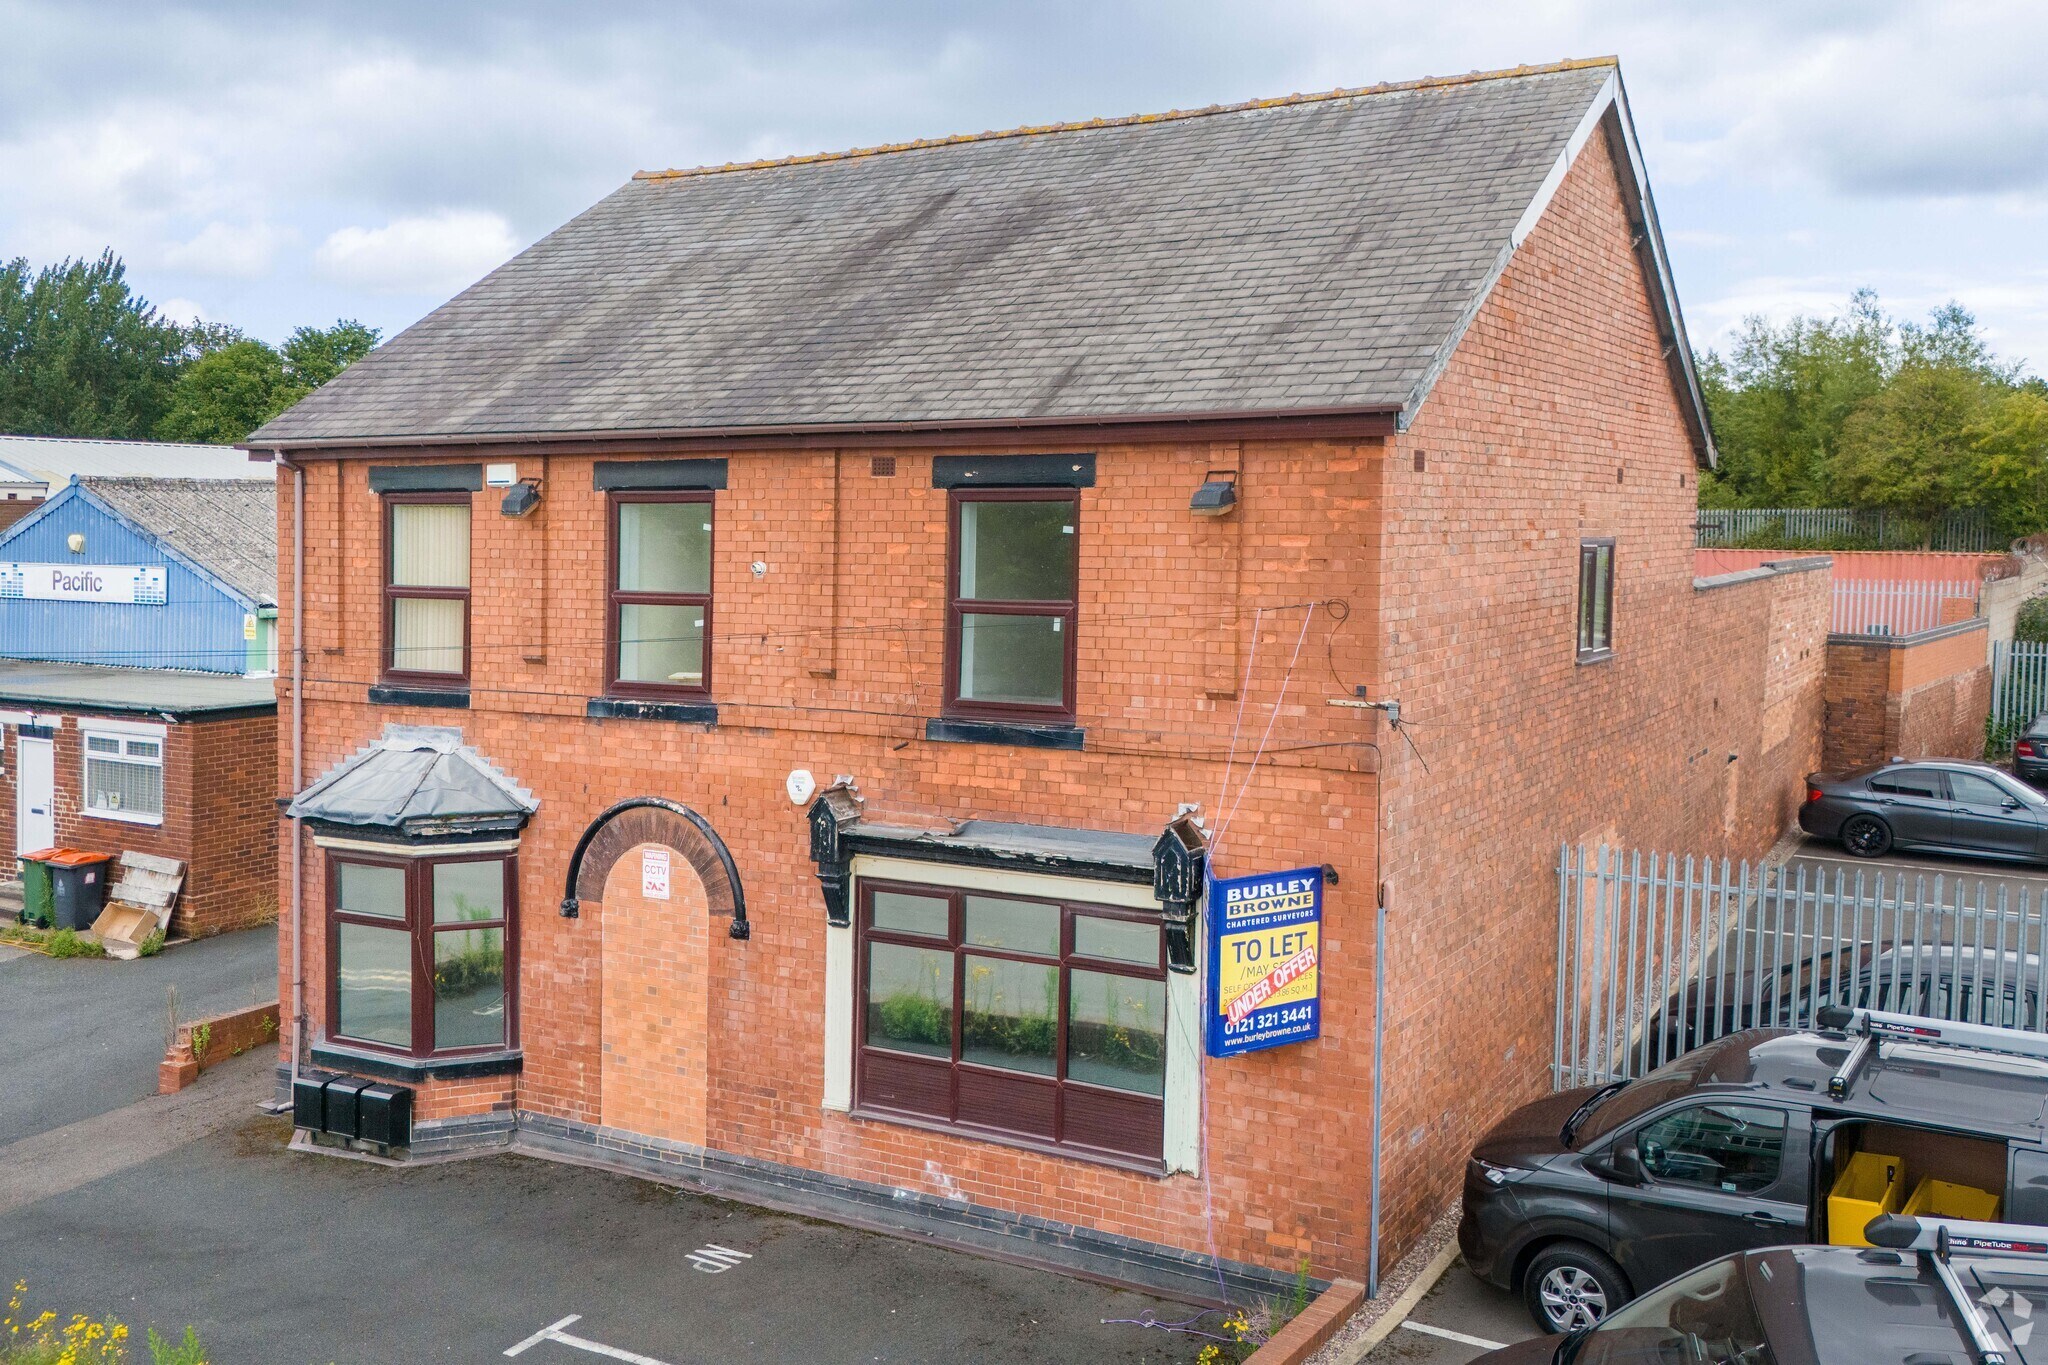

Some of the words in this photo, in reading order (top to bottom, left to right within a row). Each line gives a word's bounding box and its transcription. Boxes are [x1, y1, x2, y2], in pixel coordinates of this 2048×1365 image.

[52, 570, 103, 593] Pacific
[645, 864, 667, 875] CCTV
[1227, 878, 1315, 902] BURLEY
[1229, 894, 1312, 915] BROWNE
[1226, 917, 1270, 929] CHARTERED
[1272, 910, 1314, 922] SURVEYORS
[1232, 939, 1262, 963] TO
[1270, 931, 1308, 958] LET
[1223, 984, 1242, 994] SELF
[1228, 978, 1272, 1023] UNDER
[1273, 947, 1316, 988] OFFER
[1224, 1016, 1254, 1035] 0121
[1257, 1011, 1278, 1029] 321
[1281, 1005, 1312, 1024] 3441
[1886, 1023, 1915, 1033] PipeTube
[1224, 1022, 1311, 1047] www.burleybrowne.co.uk
[1948, 1238, 1967, 1246] hino
[1973, 1239, 2012, 1249] PipeTube
